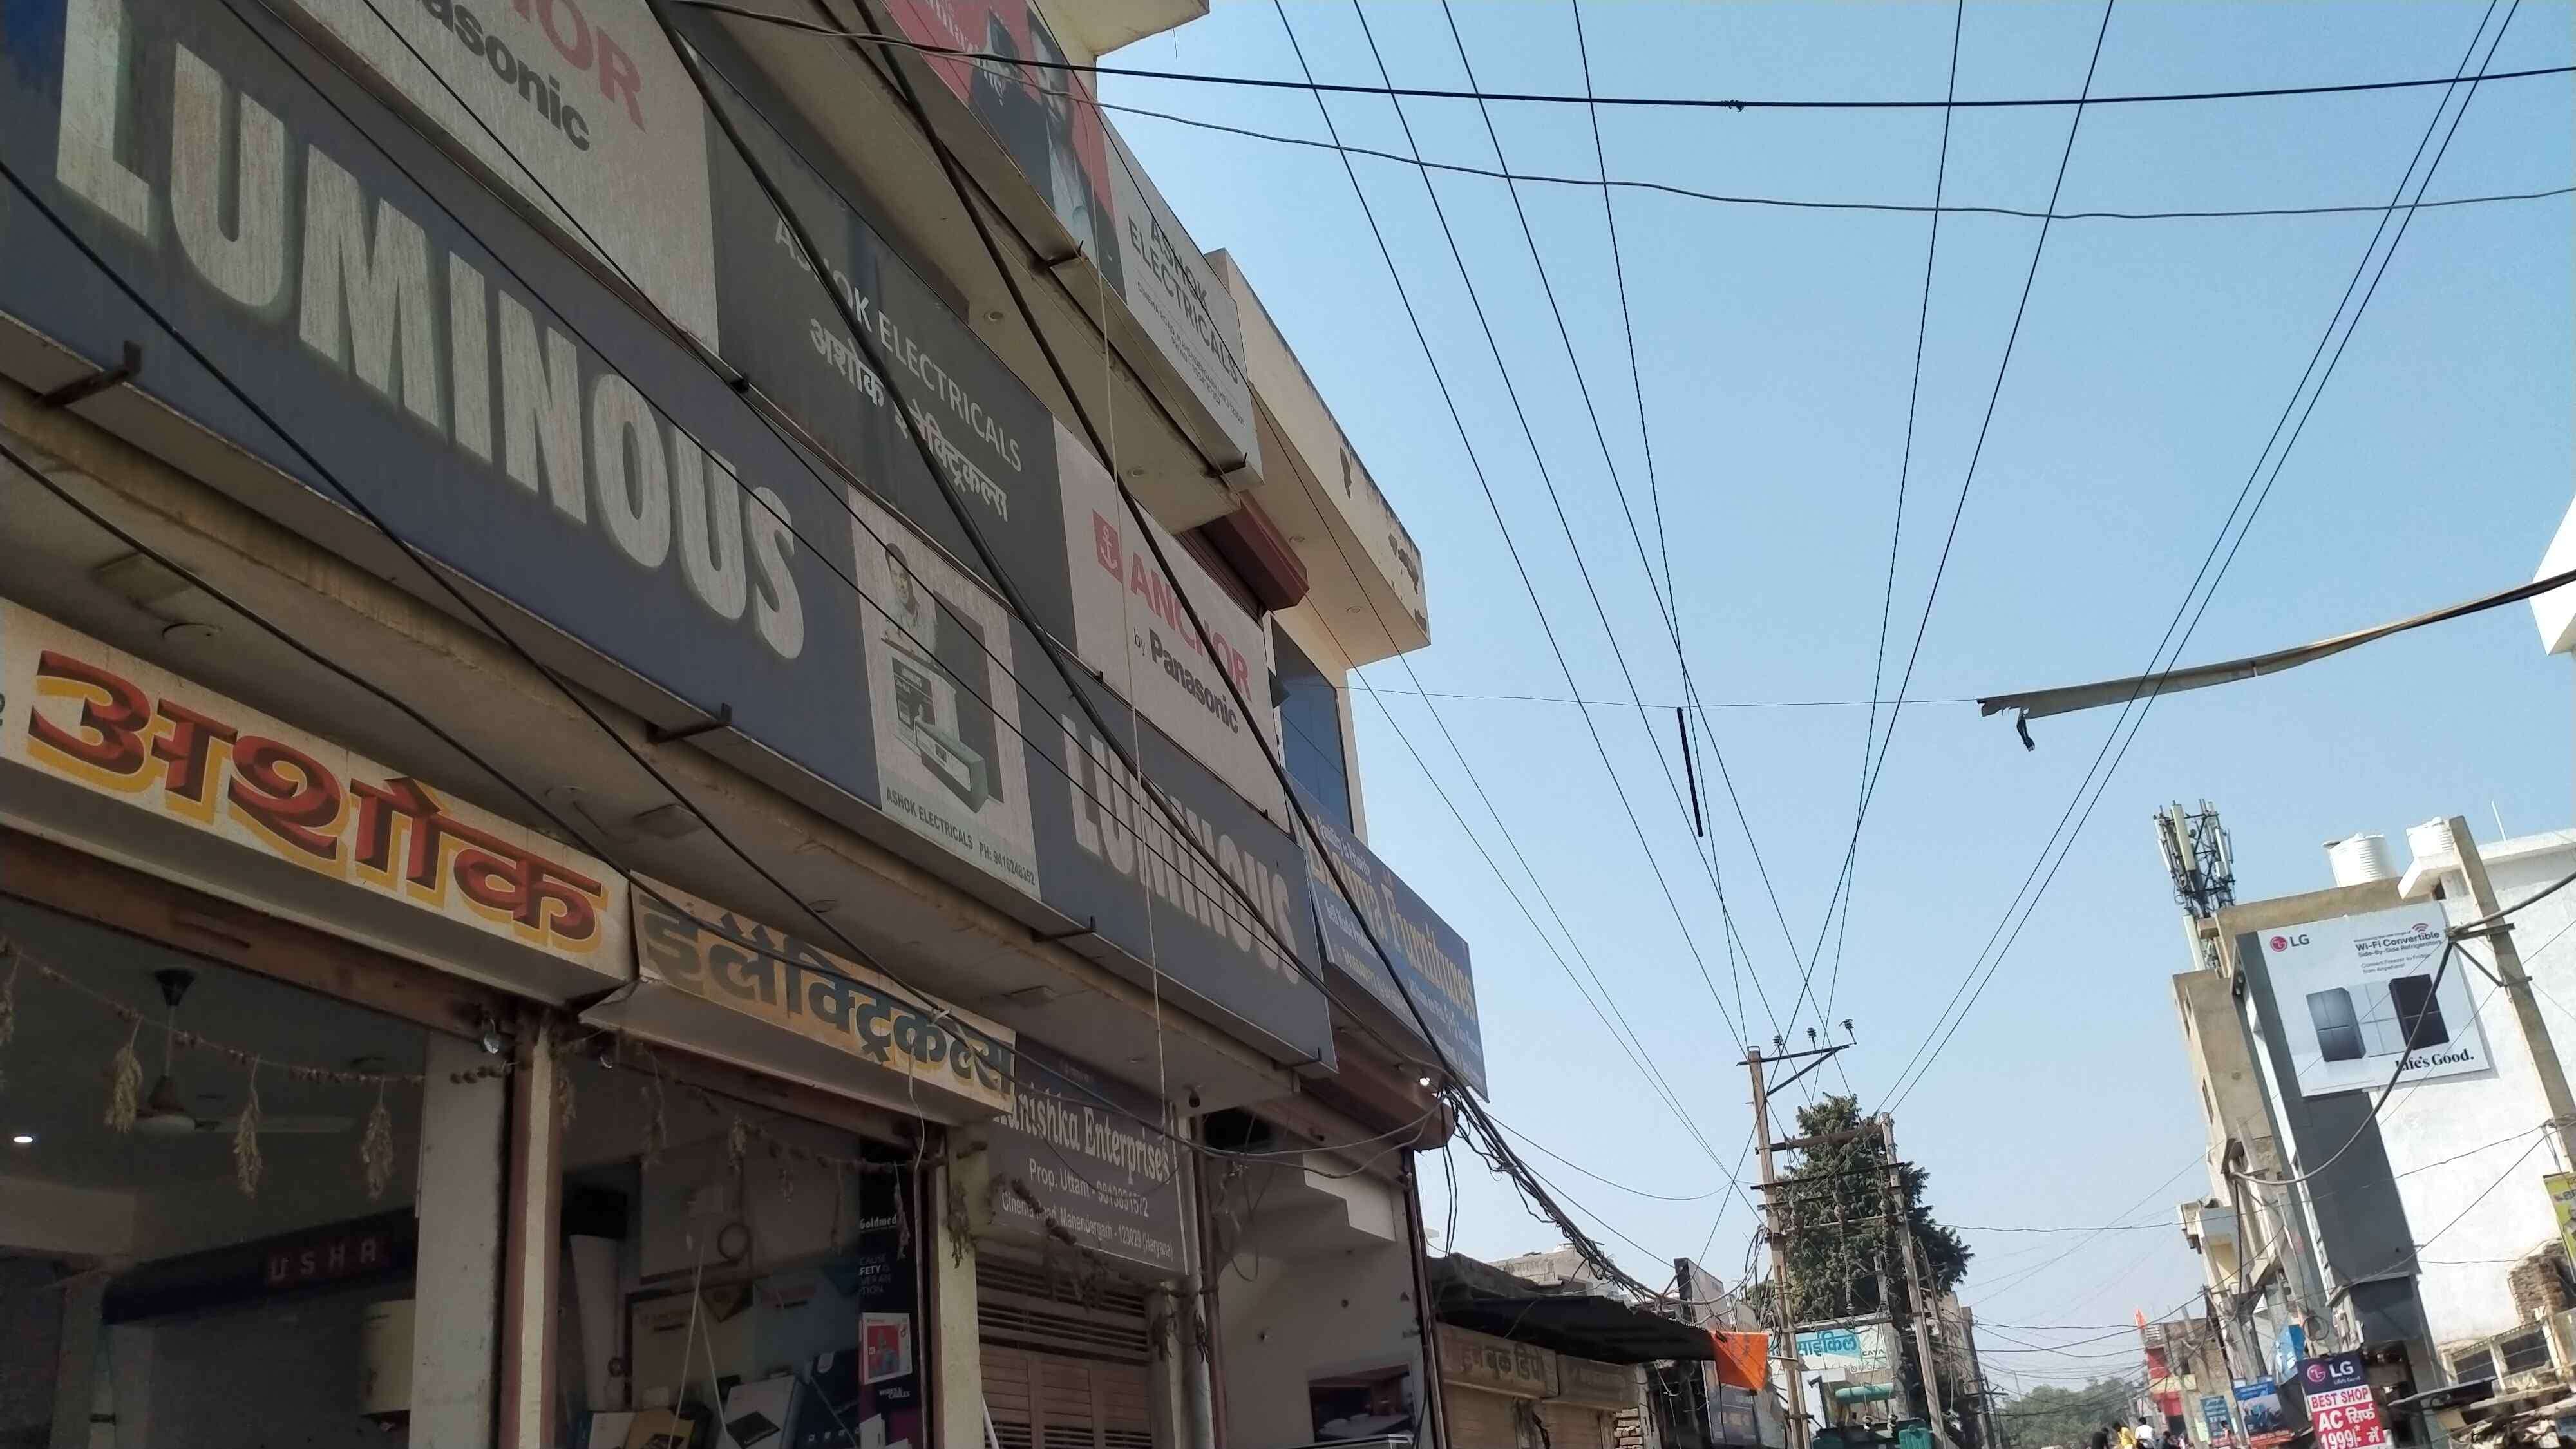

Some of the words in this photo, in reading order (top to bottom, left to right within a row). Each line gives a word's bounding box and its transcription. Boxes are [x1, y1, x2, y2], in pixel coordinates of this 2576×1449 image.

[57, 0, 804, 659] LUMINOUS
[1128, 216, 1238, 385] ELECTRICALS
[878, 310, 1022, 473] ELECTRICALS
[1133, 628, 1146, 656] by
[1149, 627, 1239, 734] Panasonic
[28, 650, 609, 952] अशोक
[886, 786, 917, 818] ASHOK
[918, 806, 974, 850] ELECTRICALS
[2289, 934, 2311, 947] LG
[2355, 940, 2382, 952] Wi-Fi
[2383, 931, 2440, 947] Convertible
[2431, 1048, 2474, 1066] Good.
[1083, 1106, 1170, 1184] Enterprises
[2311, 1393, 2338, 1408] BEST
[2341, 1387, 2368, 1403] SHOP
[2329, 1361, 2355, 1378] LG
[2318, 1410, 2344, 1432] AC
